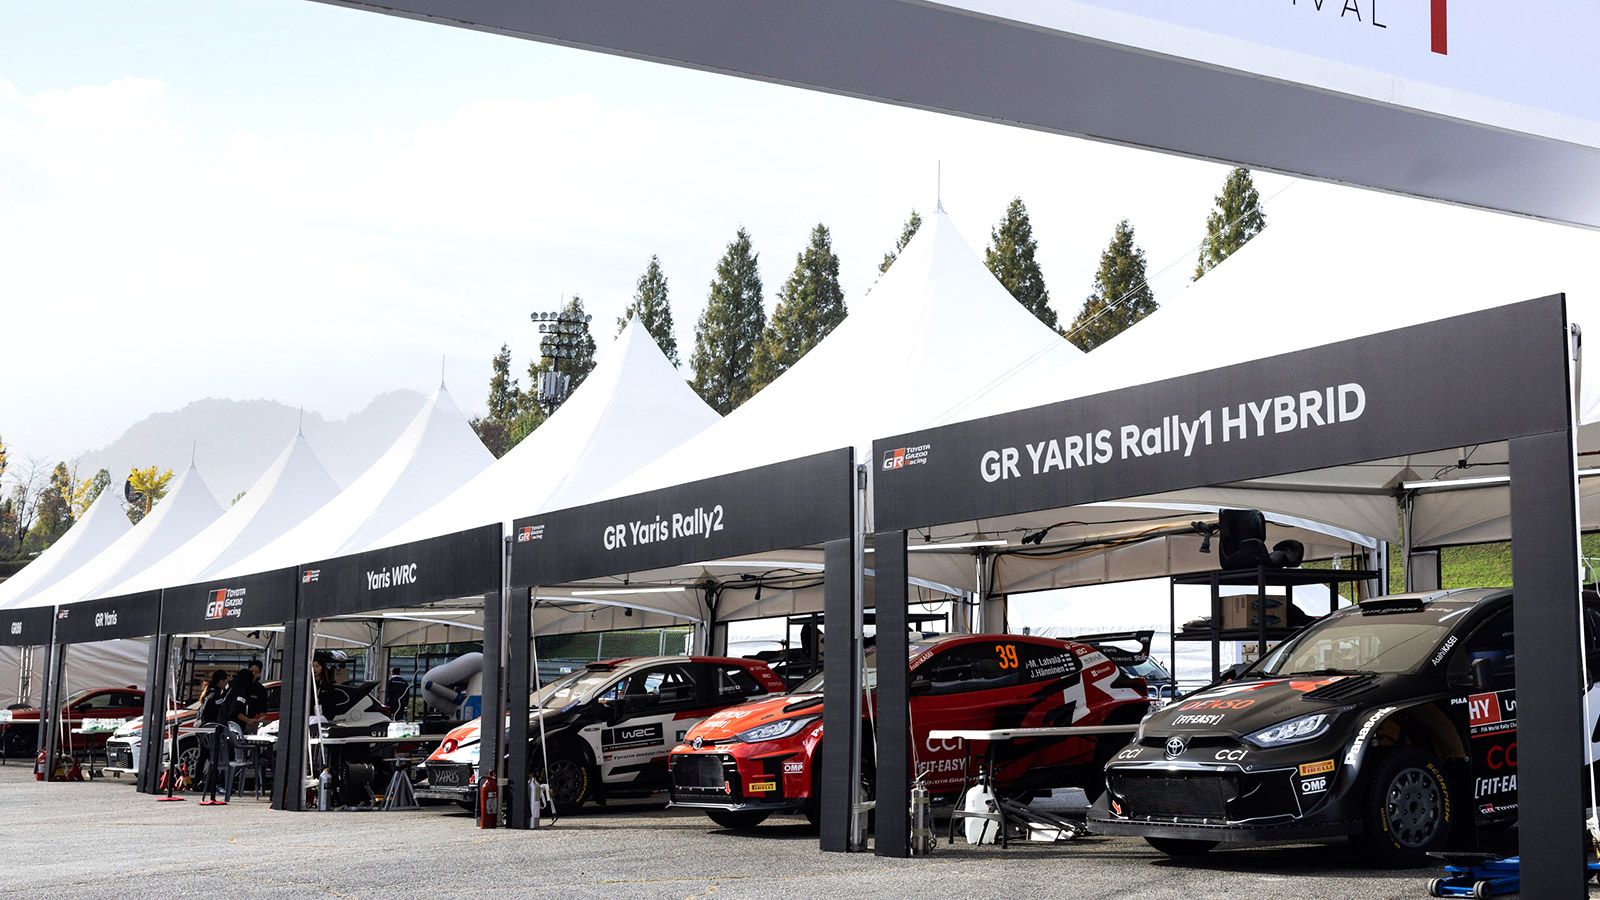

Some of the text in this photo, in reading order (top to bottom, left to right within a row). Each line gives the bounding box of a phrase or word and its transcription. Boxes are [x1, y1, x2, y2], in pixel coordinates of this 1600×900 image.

[980, 382, 1366, 483] GR YARIS Rally1 HYBRID
[905, 451, 929, 460] GAZOO
[906, 444, 931, 453] TOYOTA
[883, 455, 904, 470] GR
[904, 457, 927, 466] Racing
[604, 504, 724, 550] GR Yaris Rally2
[366, 563, 417, 590] Yaris WRC
[226, 588, 246, 597] TOYOTA
[206, 600, 224, 618] GR
[223, 607, 241, 618] Racing
[95, 610, 118, 627] GR Yaris
[996, 644, 1019, 670] 39
[1431, 635, 1458, 666] AsahiKASEI
[1177, 699, 1257, 711] DENSO
[1450, 697, 1468, 705] PIAA
[1468, 698, 1490, 720] HY
[621, 727, 655, 739] WRC
[1343, 706, 1397, 766] Panasonic
[1118, 748, 1249, 761] CCI CCI
[1487, 742, 1518, 770] CC
[433, 768, 459, 783] YARIS
[784, 764, 804, 772] OMP
[1302, 762, 1334, 774] PIRELLI
[1301, 779, 1327, 793] OMP
[1426, 763, 1450, 823] SCORPION
